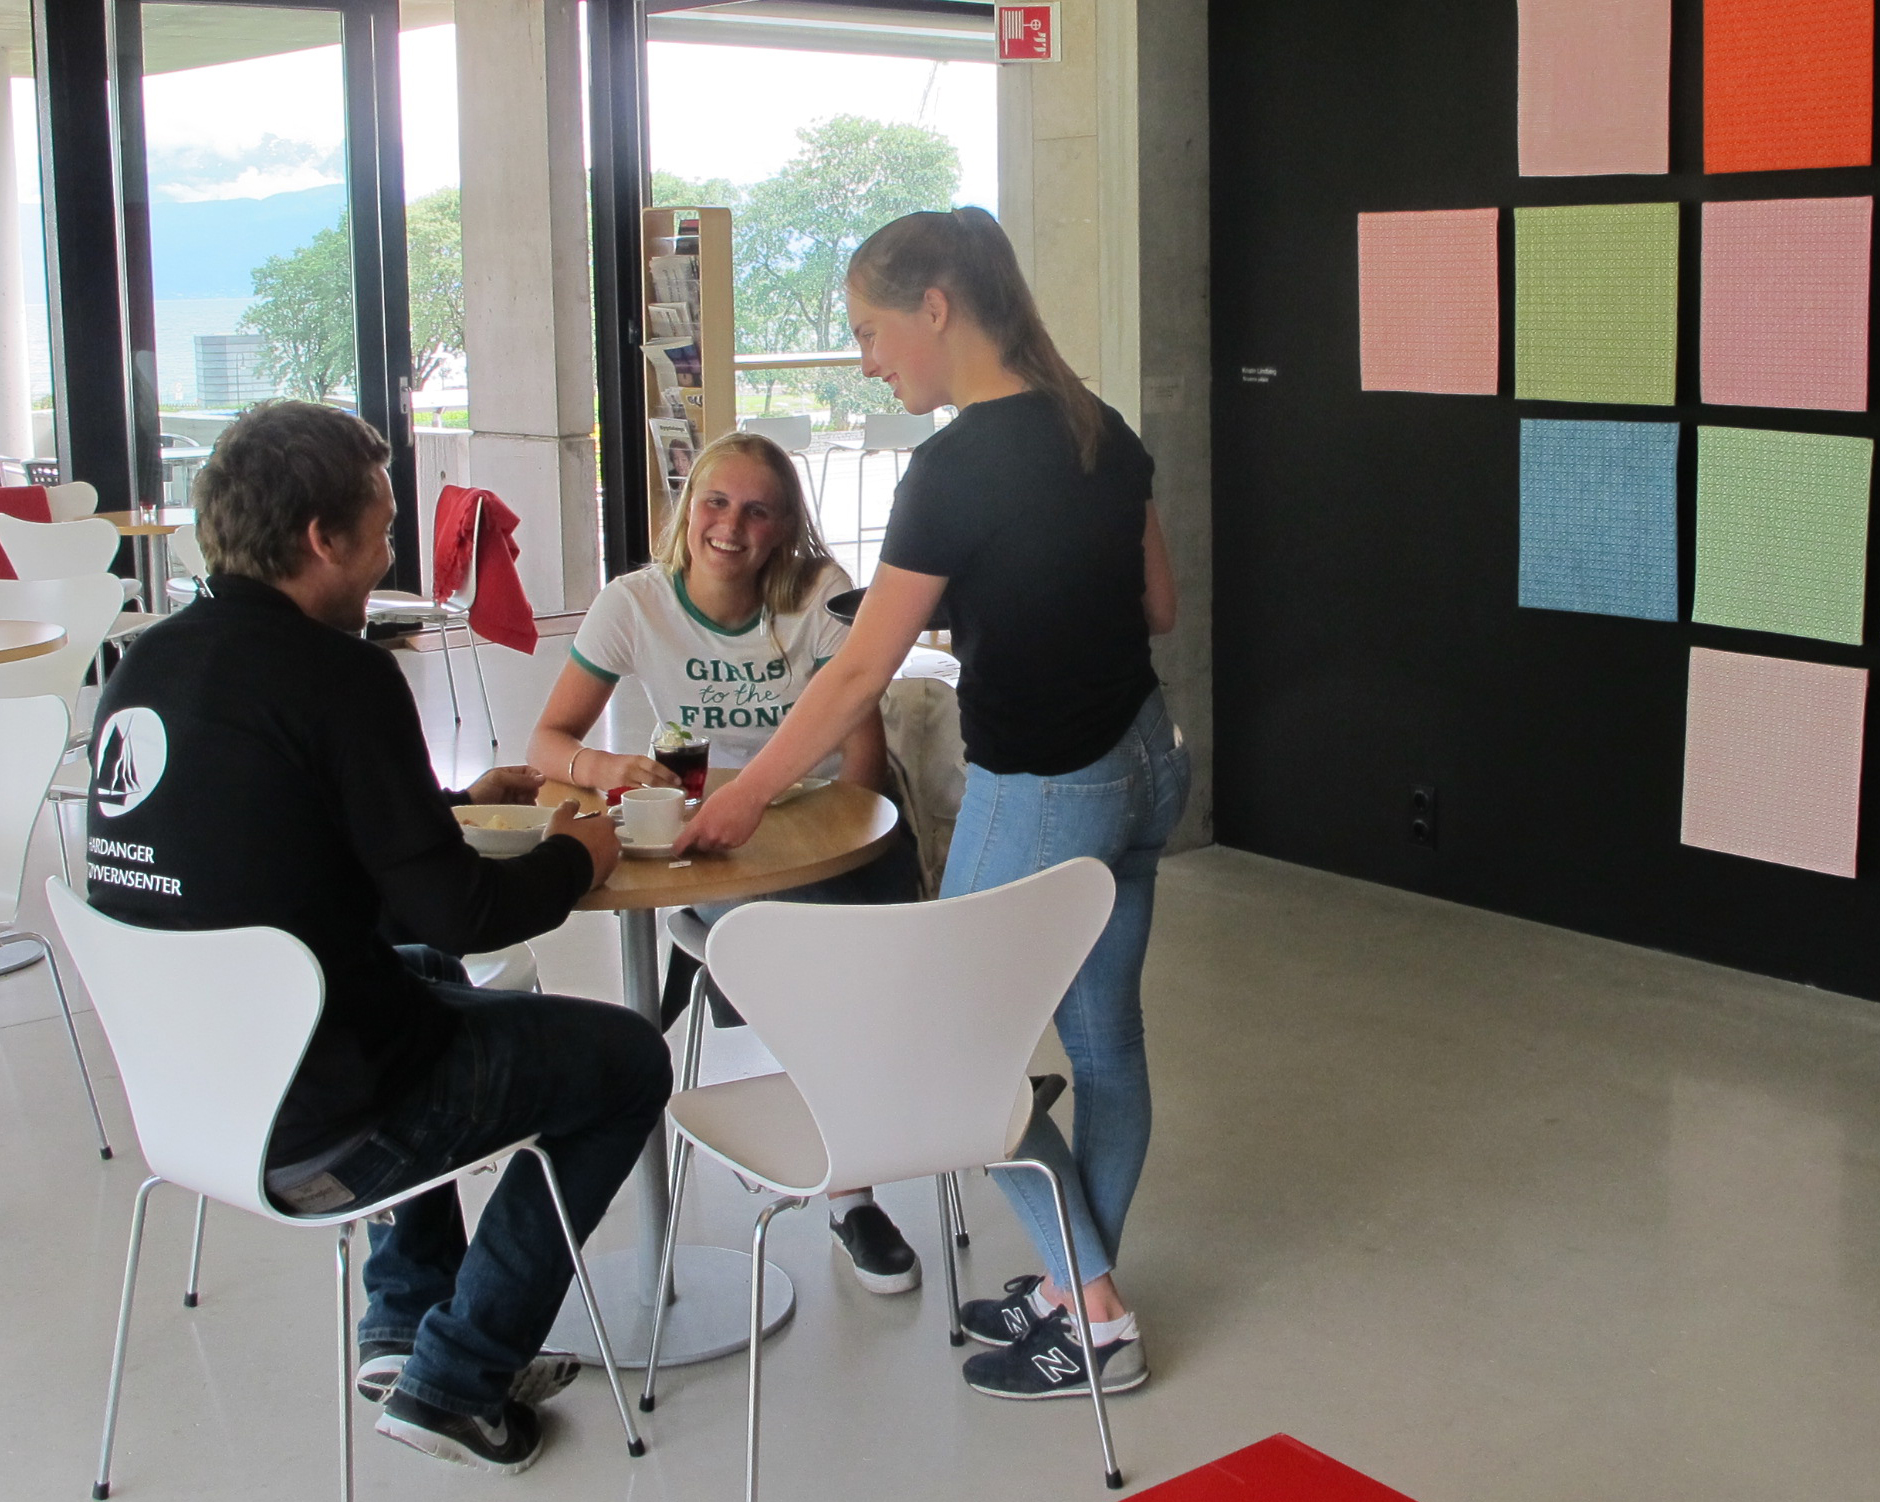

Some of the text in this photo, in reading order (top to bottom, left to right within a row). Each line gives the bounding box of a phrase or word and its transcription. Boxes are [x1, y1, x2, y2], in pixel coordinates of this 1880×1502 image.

[686, 658, 785, 683] GIRLS
[699, 683, 780, 706] to the
[1001, 1307, 1030, 1339] N
[1031, 1346, 1081, 1383] N
